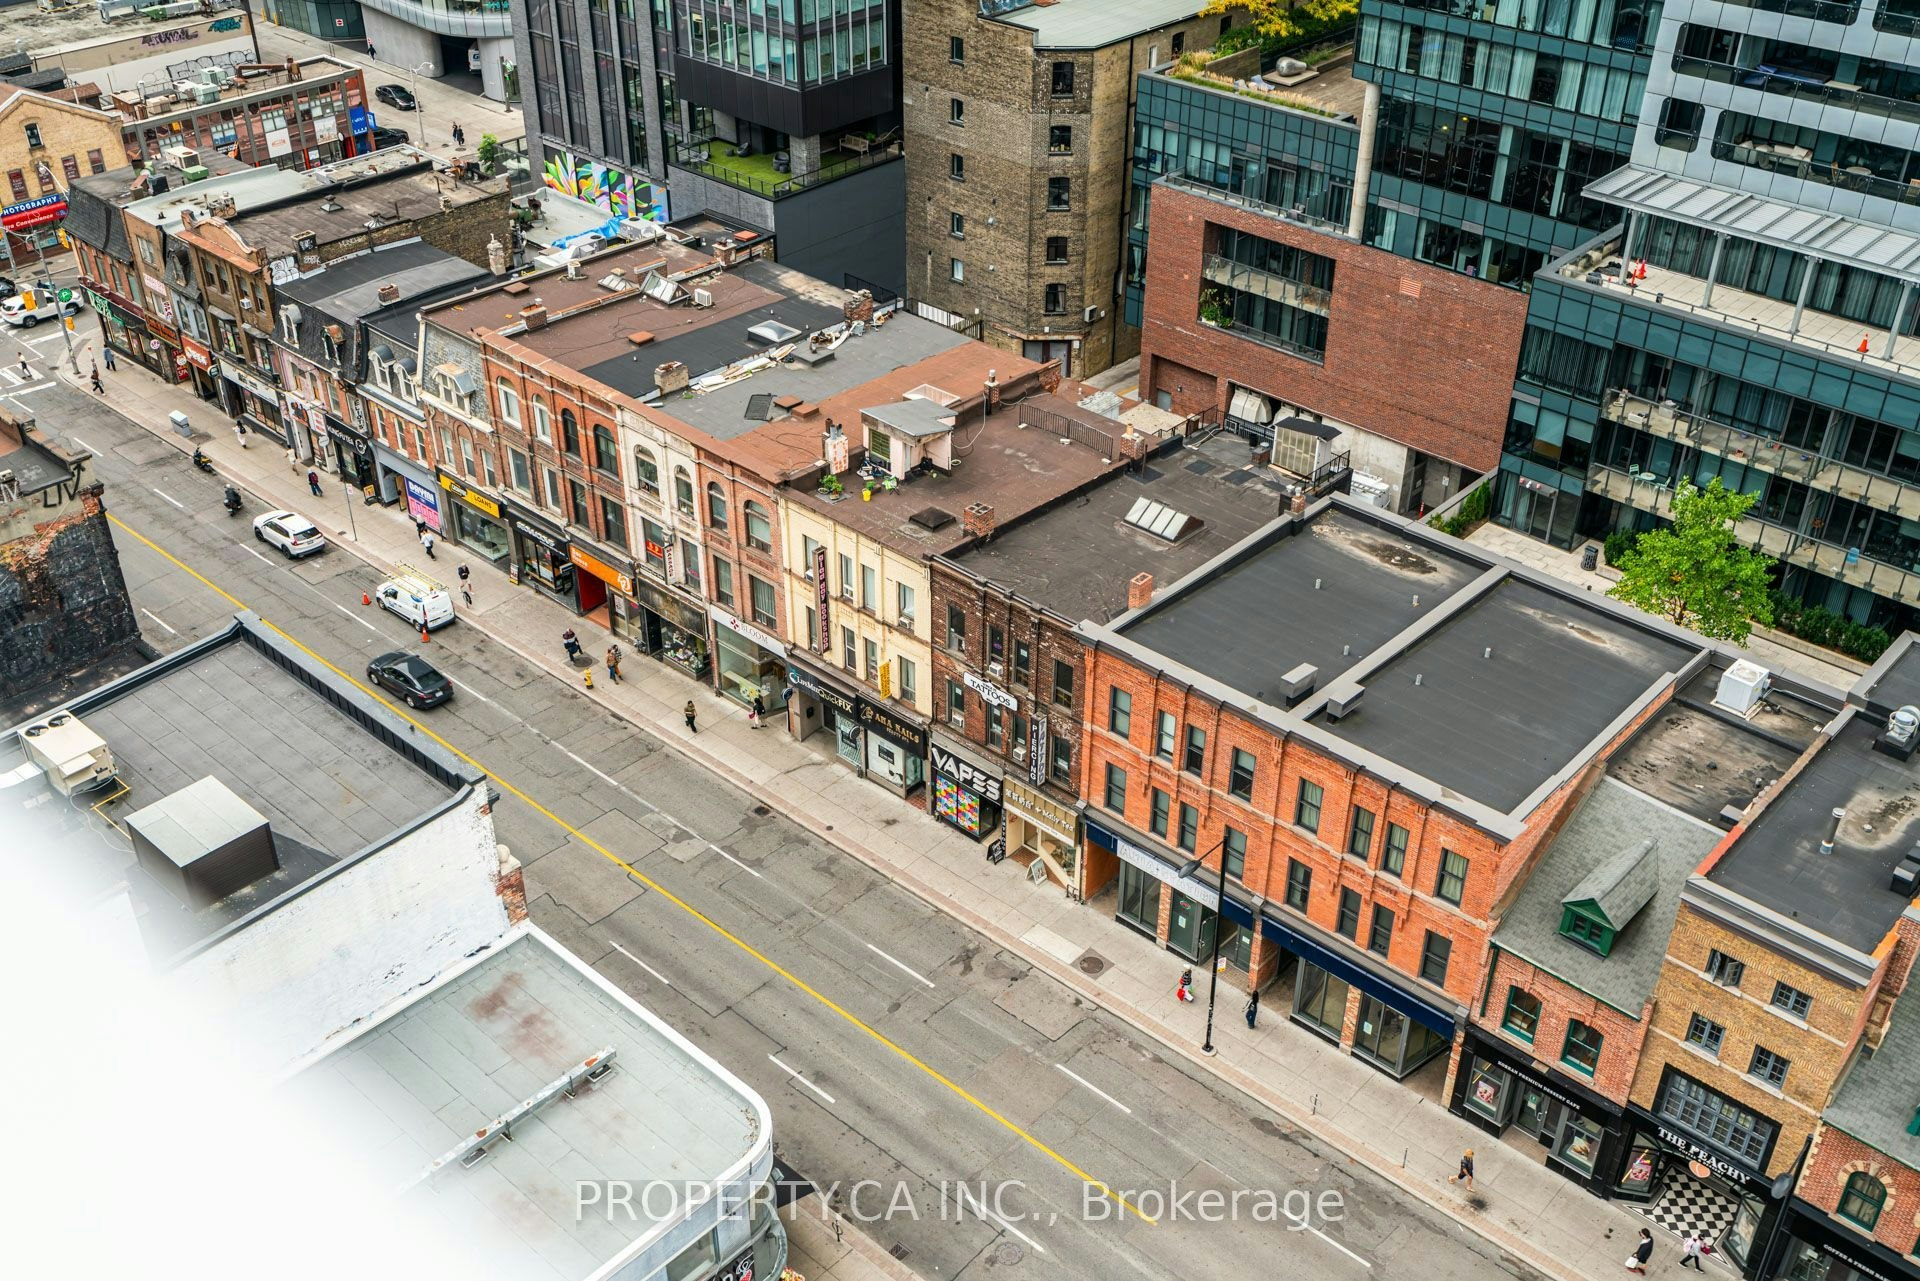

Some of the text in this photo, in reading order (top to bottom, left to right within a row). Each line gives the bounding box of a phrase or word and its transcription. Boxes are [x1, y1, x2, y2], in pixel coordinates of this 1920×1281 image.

[474, 495, 492, 509] LOANS
[740, 624, 769, 644] BLOOM
[970, 679, 1011, 707] TATTOOS
[895, 723, 920, 744] NAILS
[1030, 724, 1038, 780] PIERCING
[931, 747, 1001, 801] VAPES
[1497, 1060, 1519, 1074] KOREAN
[1518, 1072, 1543, 1089] PREMIUM
[1543, 1086, 1567, 1102] DESSERT
[1657, 1126, 1751, 1185] THE PEACHY
[1823, 1244, 1848, 1260] COFFEE
[1853, 1260, 1876, 1275] FRESH
